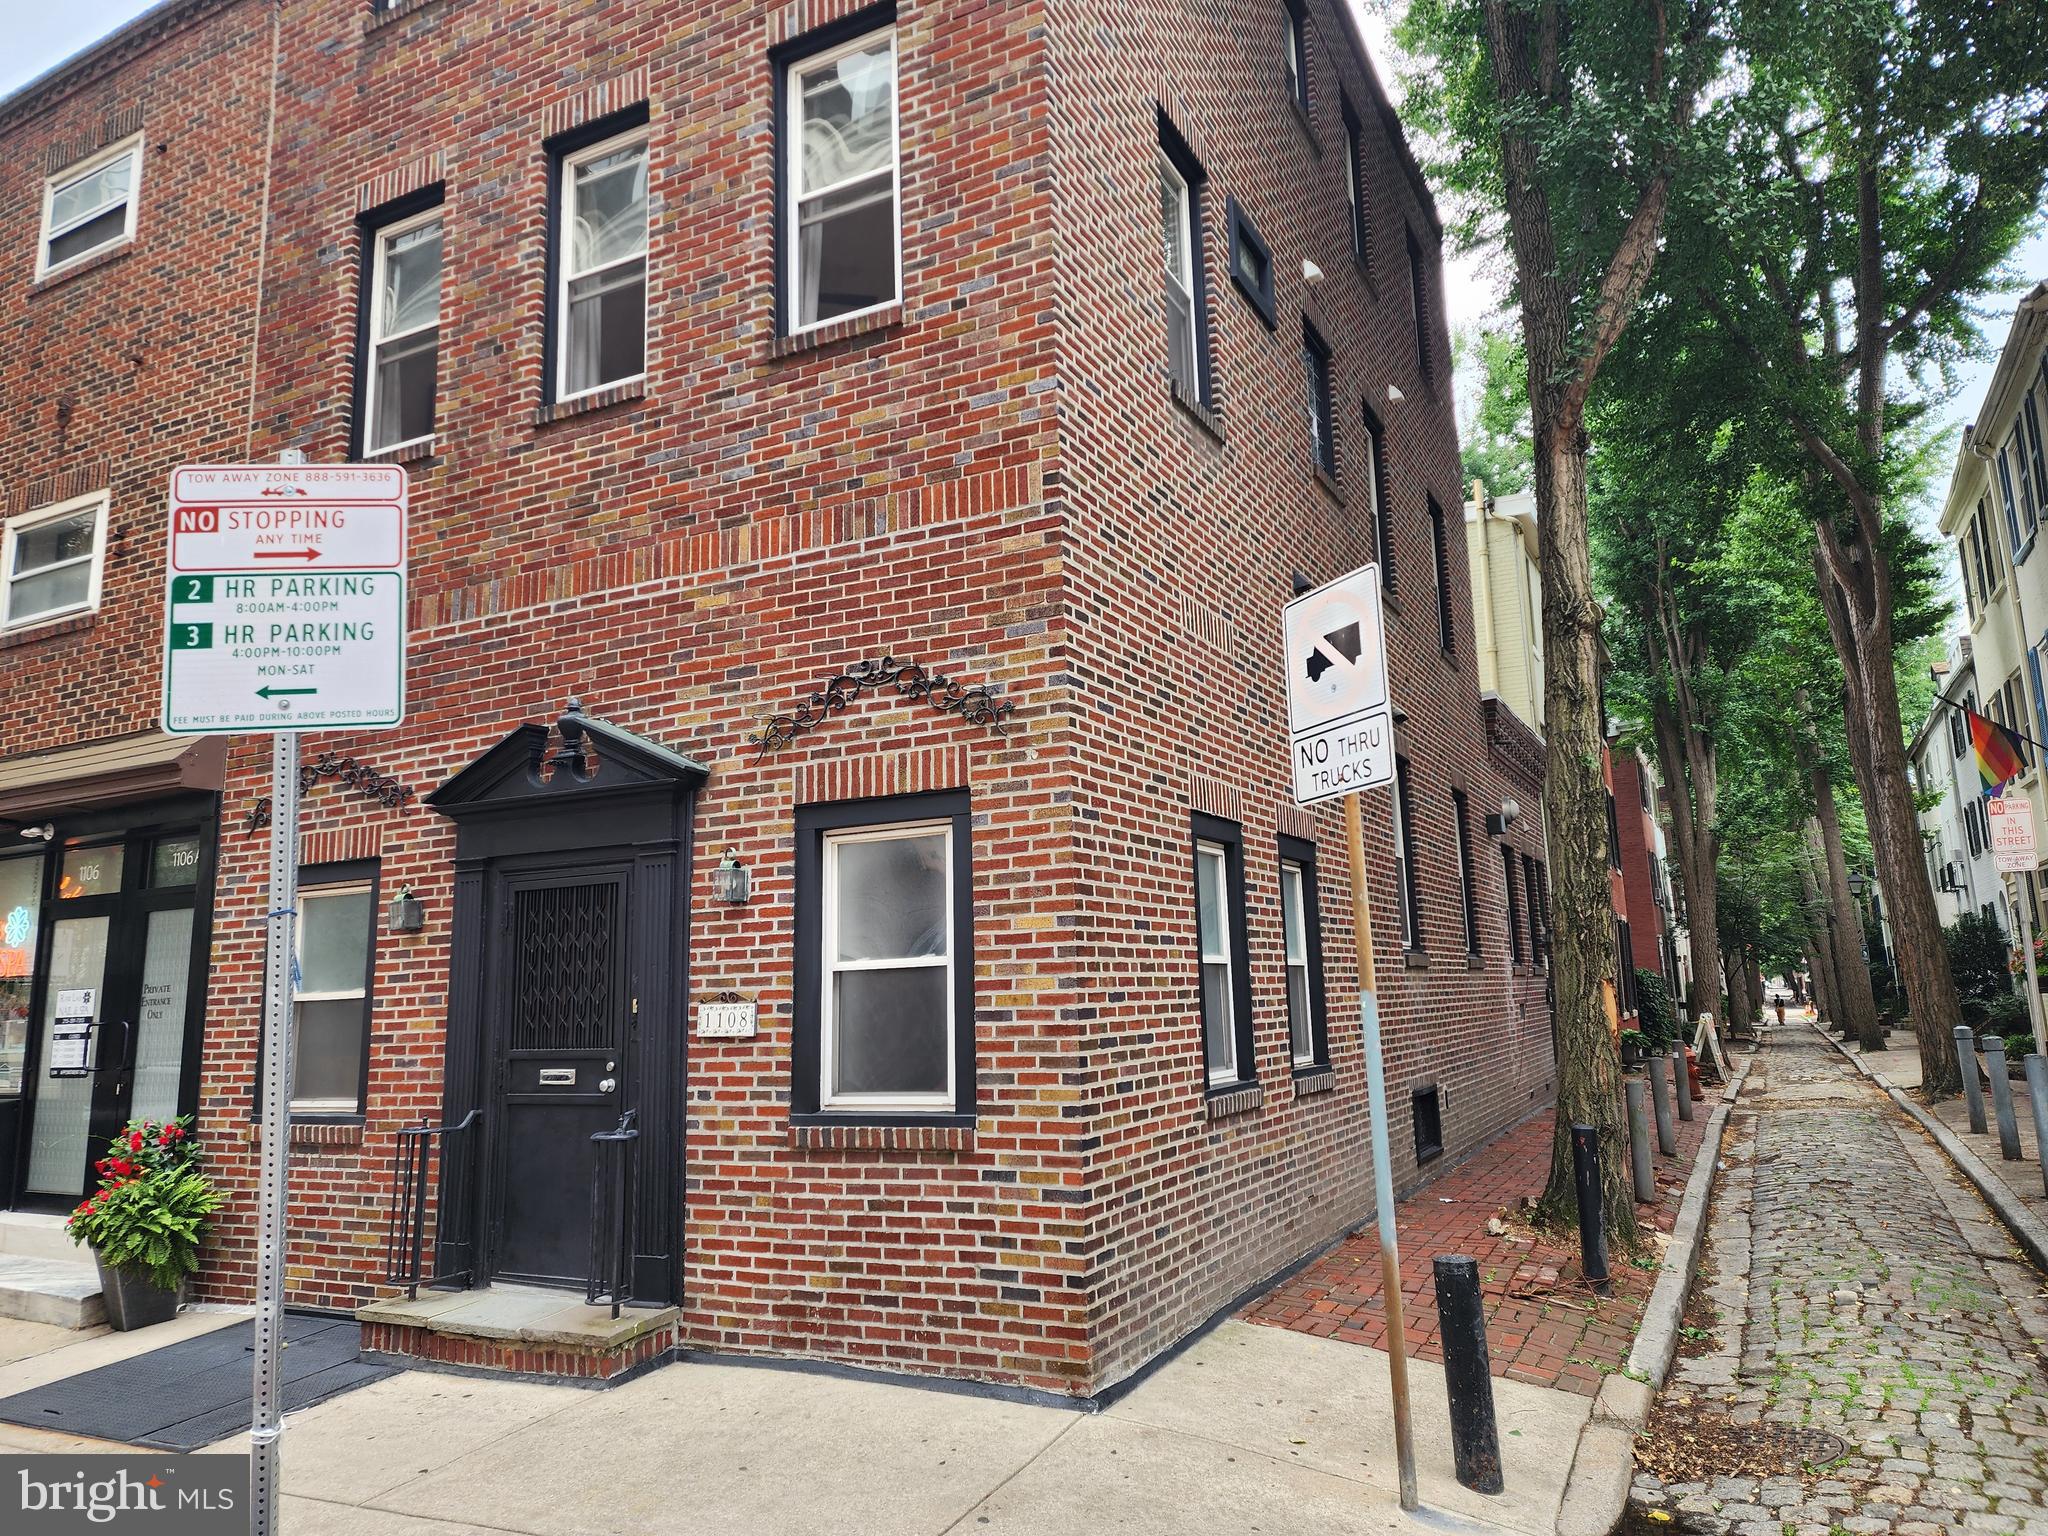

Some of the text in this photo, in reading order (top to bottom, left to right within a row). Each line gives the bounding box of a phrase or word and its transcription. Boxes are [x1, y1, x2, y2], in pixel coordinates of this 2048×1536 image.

[188, 472, 392, 484] TOW AWAY ZONE 888-591-3636
[180, 510, 346, 532] NO STOPPING
[256, 534, 323, 545] ANY TIME
[188, 577, 376, 600] 2 HR PARKING
[236, 602, 339, 614] 8:00AM-4:00PM
[186, 622, 375, 647] 3 HR PARKING
[232, 645, 342, 659] 4:00PM-10:00PM
[257, 664, 316, 677] MON-SAT
[173, 708, 395, 725] FEE MUST BE PAID DURING ABOVE POSTED HOURS
[1301, 727, 1380, 769] NO THRU
[1312, 759, 1372, 791] TRUCKS
[1990, 802, 2029, 815] NO PARKING
[2006, 816, 2016, 825] IN
[2002, 826, 2024, 835] THIS
[1996, 836, 2032, 847] STREET
[1998, 855, 2034, 863] TOW-AWAY
[80, 864, 100, 881] 1106
[706, 1011, 748, 1028] 1108
